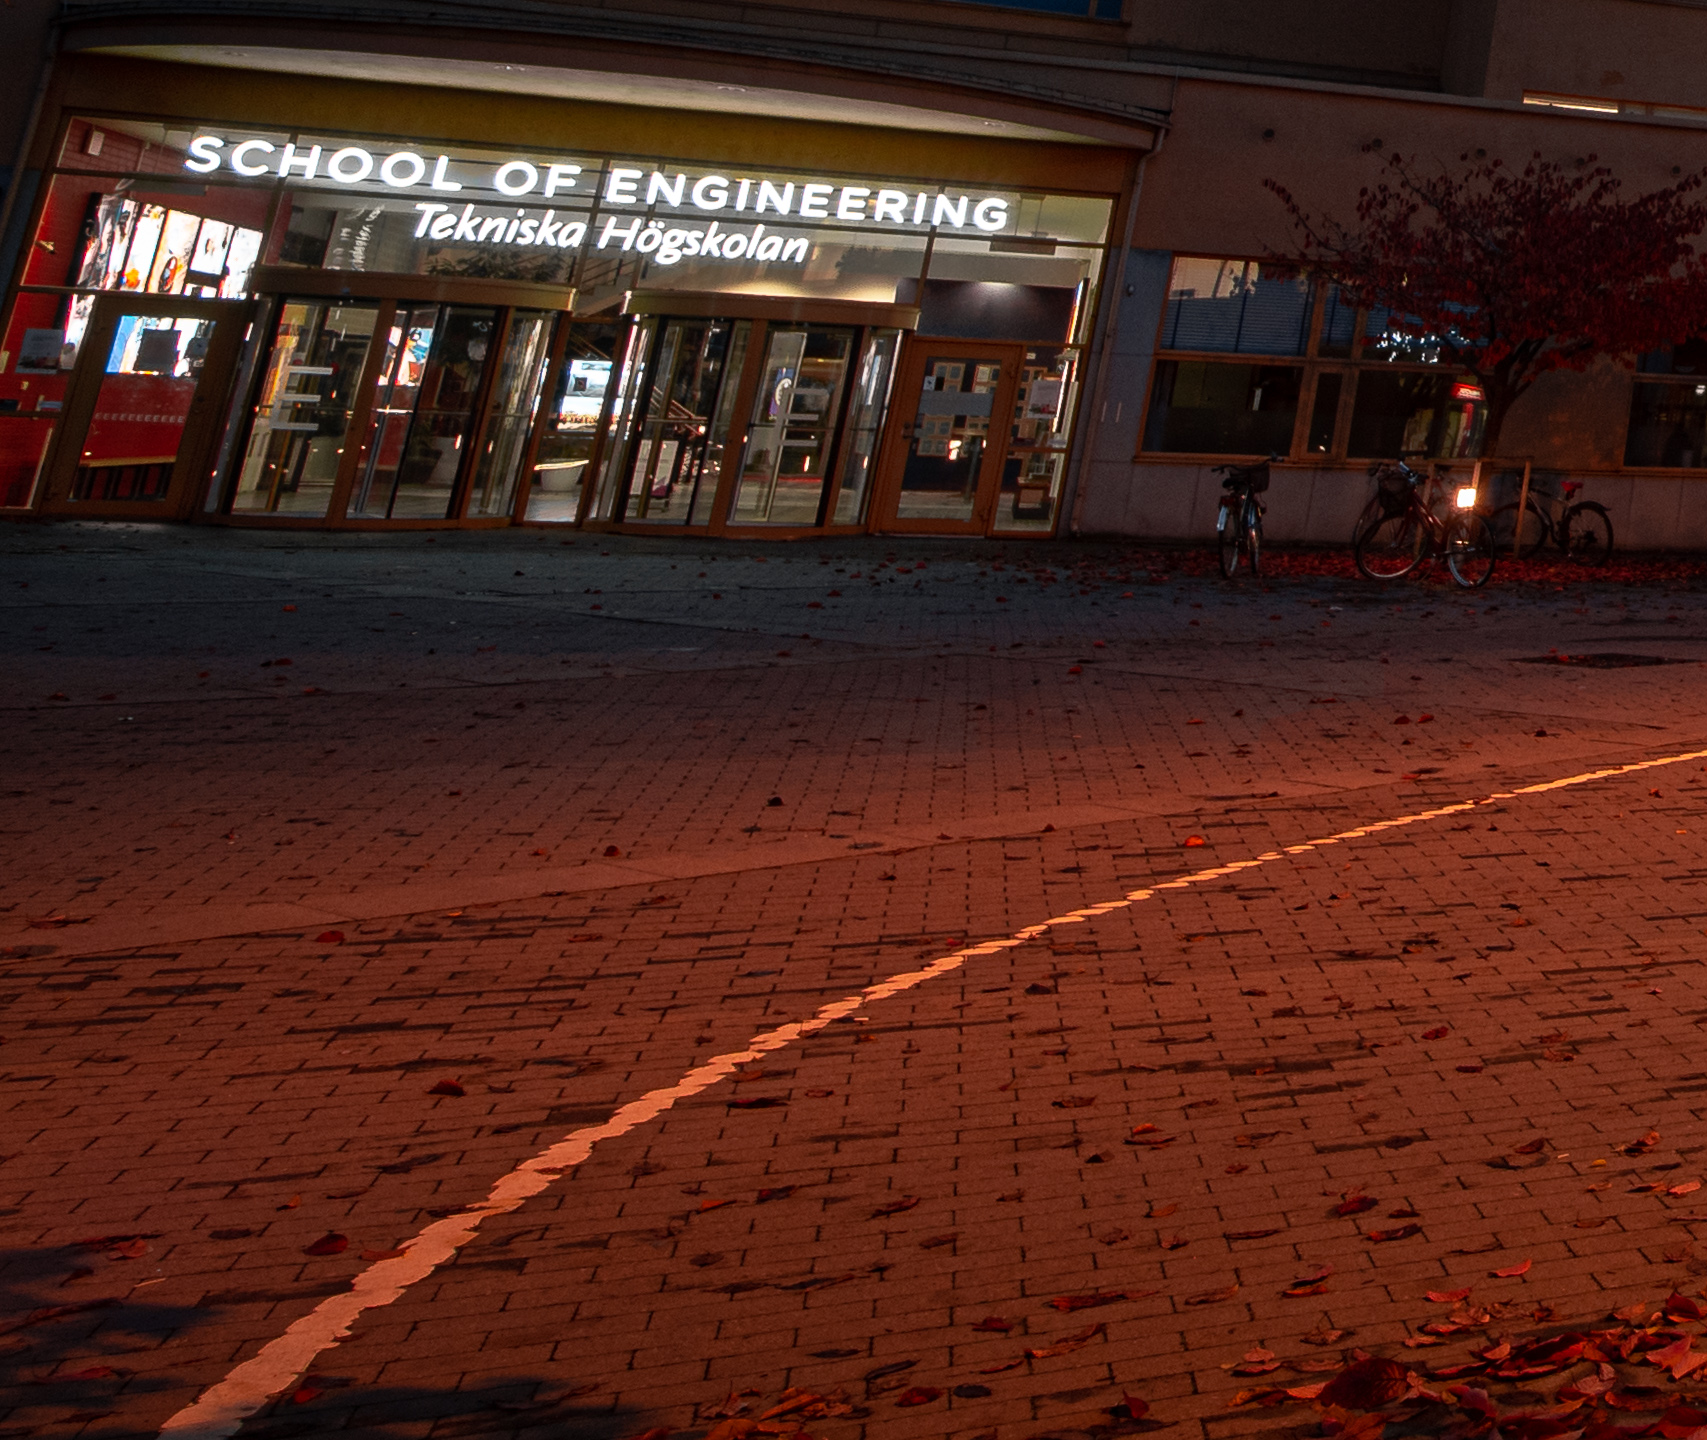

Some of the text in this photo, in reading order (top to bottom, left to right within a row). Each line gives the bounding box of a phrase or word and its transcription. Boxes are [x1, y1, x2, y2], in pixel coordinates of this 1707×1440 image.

[185, 136, 1009, 232] SCHOOL OF ENGINEERING
[414, 202, 588, 248] Tekniska
[597, 215, 810, 265] Högskolan
